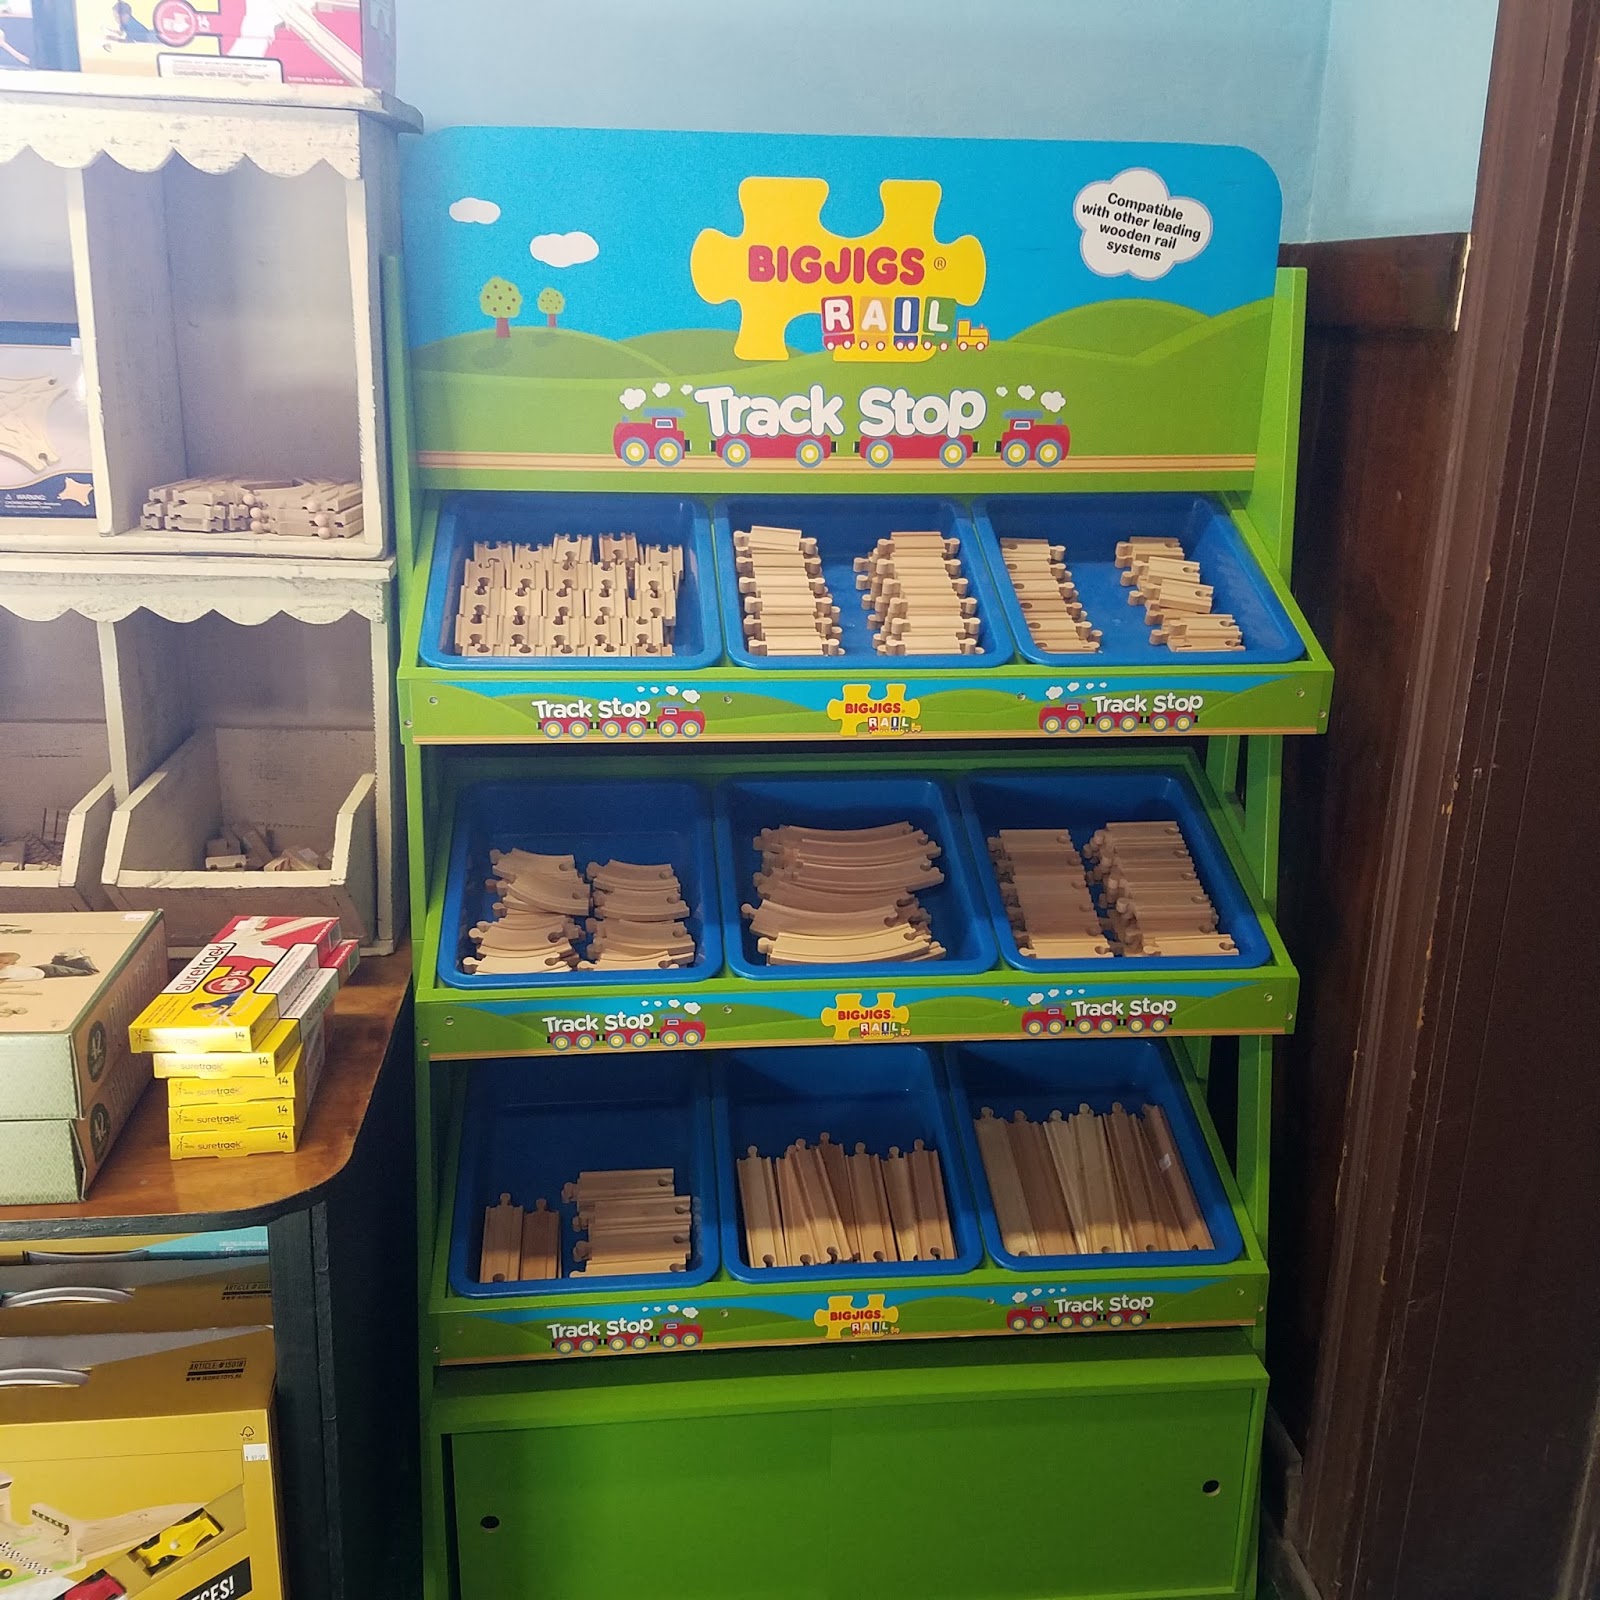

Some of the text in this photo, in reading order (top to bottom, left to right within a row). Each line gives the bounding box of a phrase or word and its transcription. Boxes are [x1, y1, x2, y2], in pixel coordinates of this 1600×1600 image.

[1107, 192, 1184, 220] Compatible
[1082, 203, 1201, 242] with other leading
[1099, 223, 1177, 250] wooden rail
[1106, 240, 1162, 261] systems
[748, 245, 925, 285] BIGJIGS
[825, 299, 949, 332] RAIL
[693, 384, 987, 438] Track Stop
[531, 697, 651, 718] Track Stop
[845, 703, 901, 714] BIGJIGS
[1091, 692, 1204, 713] Track Stop
[868, 717, 909, 727] RAIL
[175, 945, 231, 991] suretrack
[837, 1009, 891, 1020] BIGJIGS
[1071, 997, 1177, 1017] Track Stop
[541, 1011, 655, 1033] Track Stop
[860, 1022, 899, 1032] RAIL
[235, 1031, 245, 1039] 14
[258, 1057, 269, 1065] 14
[197, 1076, 289, 1096] suretrack 14
[197, 1105, 288, 1124] suretrack 14
[198, 1132, 288, 1149] suretrack 14
[1053, 1294, 1154, 1313] Track Stop
[830, 1310, 881, 1321] BIGJIGS
[547, 1317, 654, 1339] Track Stop
[851, 1321, 888, 1331] RAIL
[189, 1362, 216, 1370] ARTICLE
